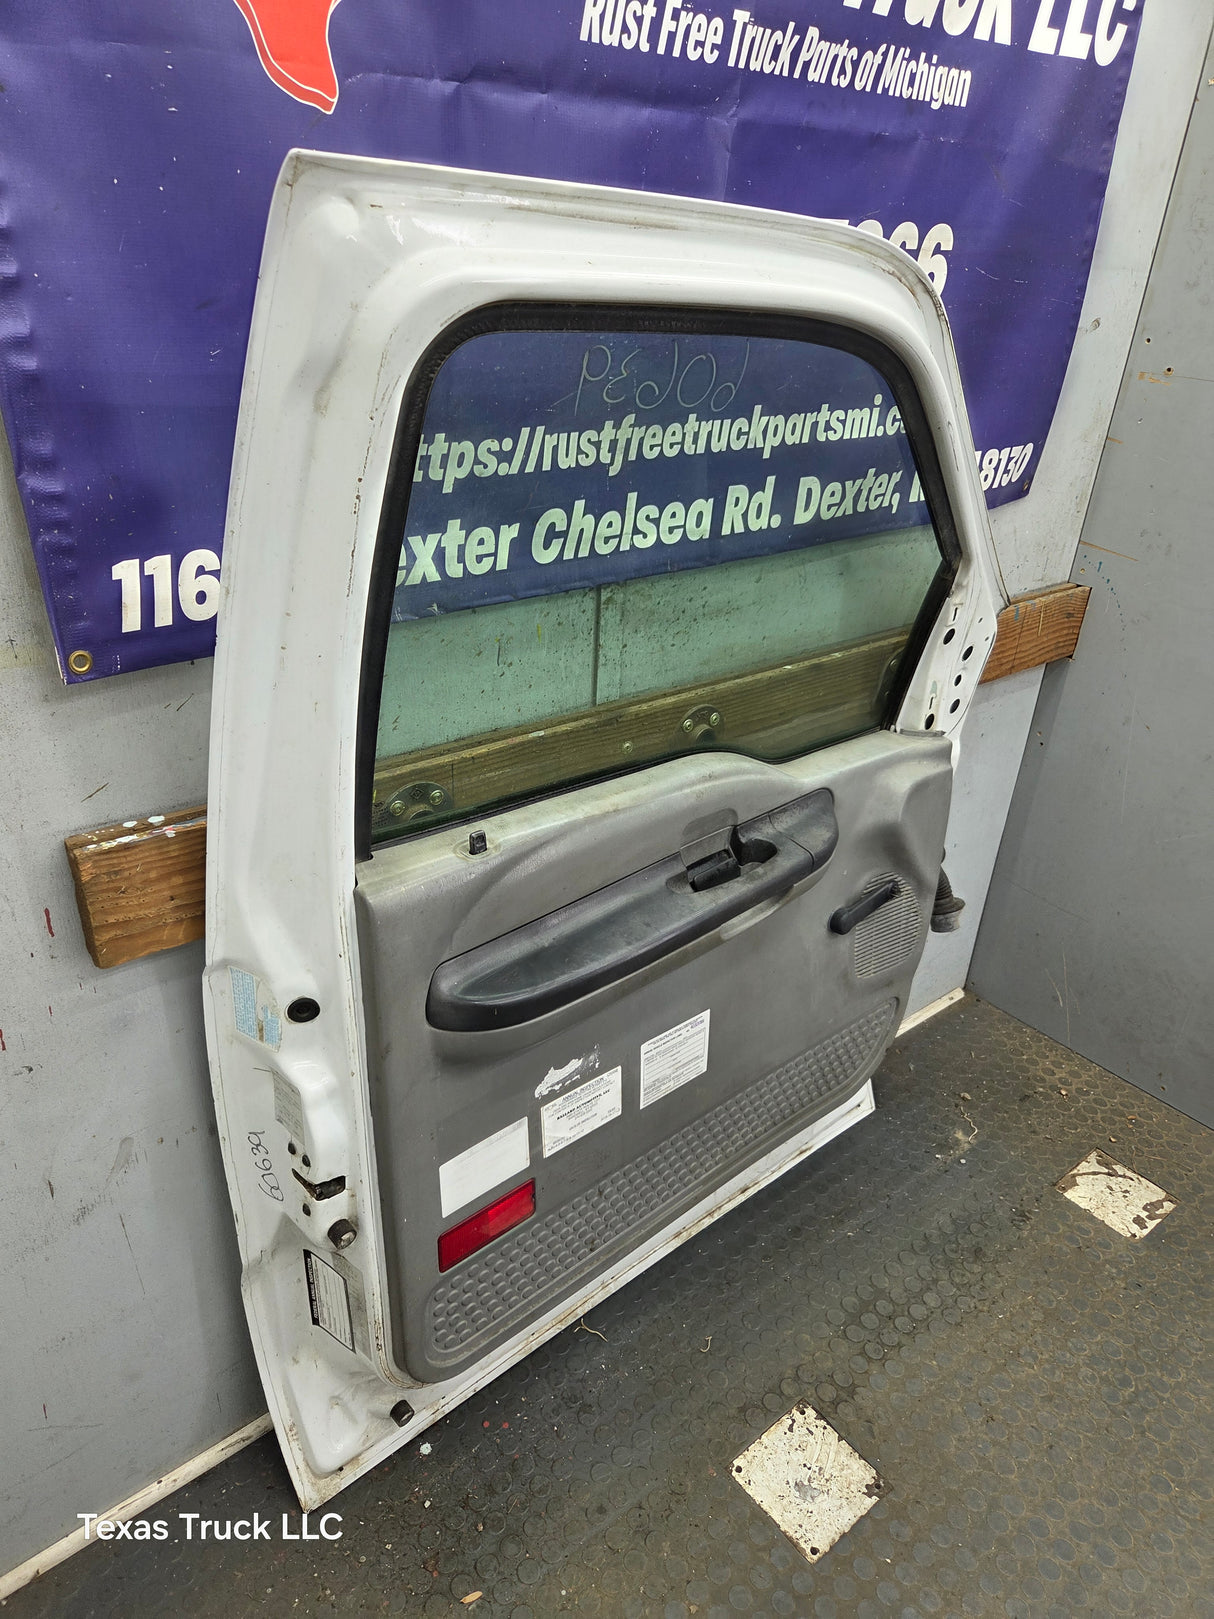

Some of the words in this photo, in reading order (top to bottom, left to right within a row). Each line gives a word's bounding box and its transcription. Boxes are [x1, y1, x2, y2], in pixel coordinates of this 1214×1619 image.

[579, 0, 657, 53] Rust
[656, 0, 725, 65] Free
[727, 8, 801, 77] Truck
[793, 26, 859, 89] Parts
[854, 43, 888, 93] of
[876, 45, 972, 110] Michigan
[1027, 0, 1134, 67] LLC
[412, 393, 906, 494] ttps://rustfreetruckpartsmi.c
[111, 548, 221, 633] 116
[531, 491, 714, 565] Chelsea
[721, 475, 782, 536] Rd.
[793, 467, 903, 526] Dexter,
[975, 442, 1034, 492] 8130
[247, 1131, 285, 1202] 60639
